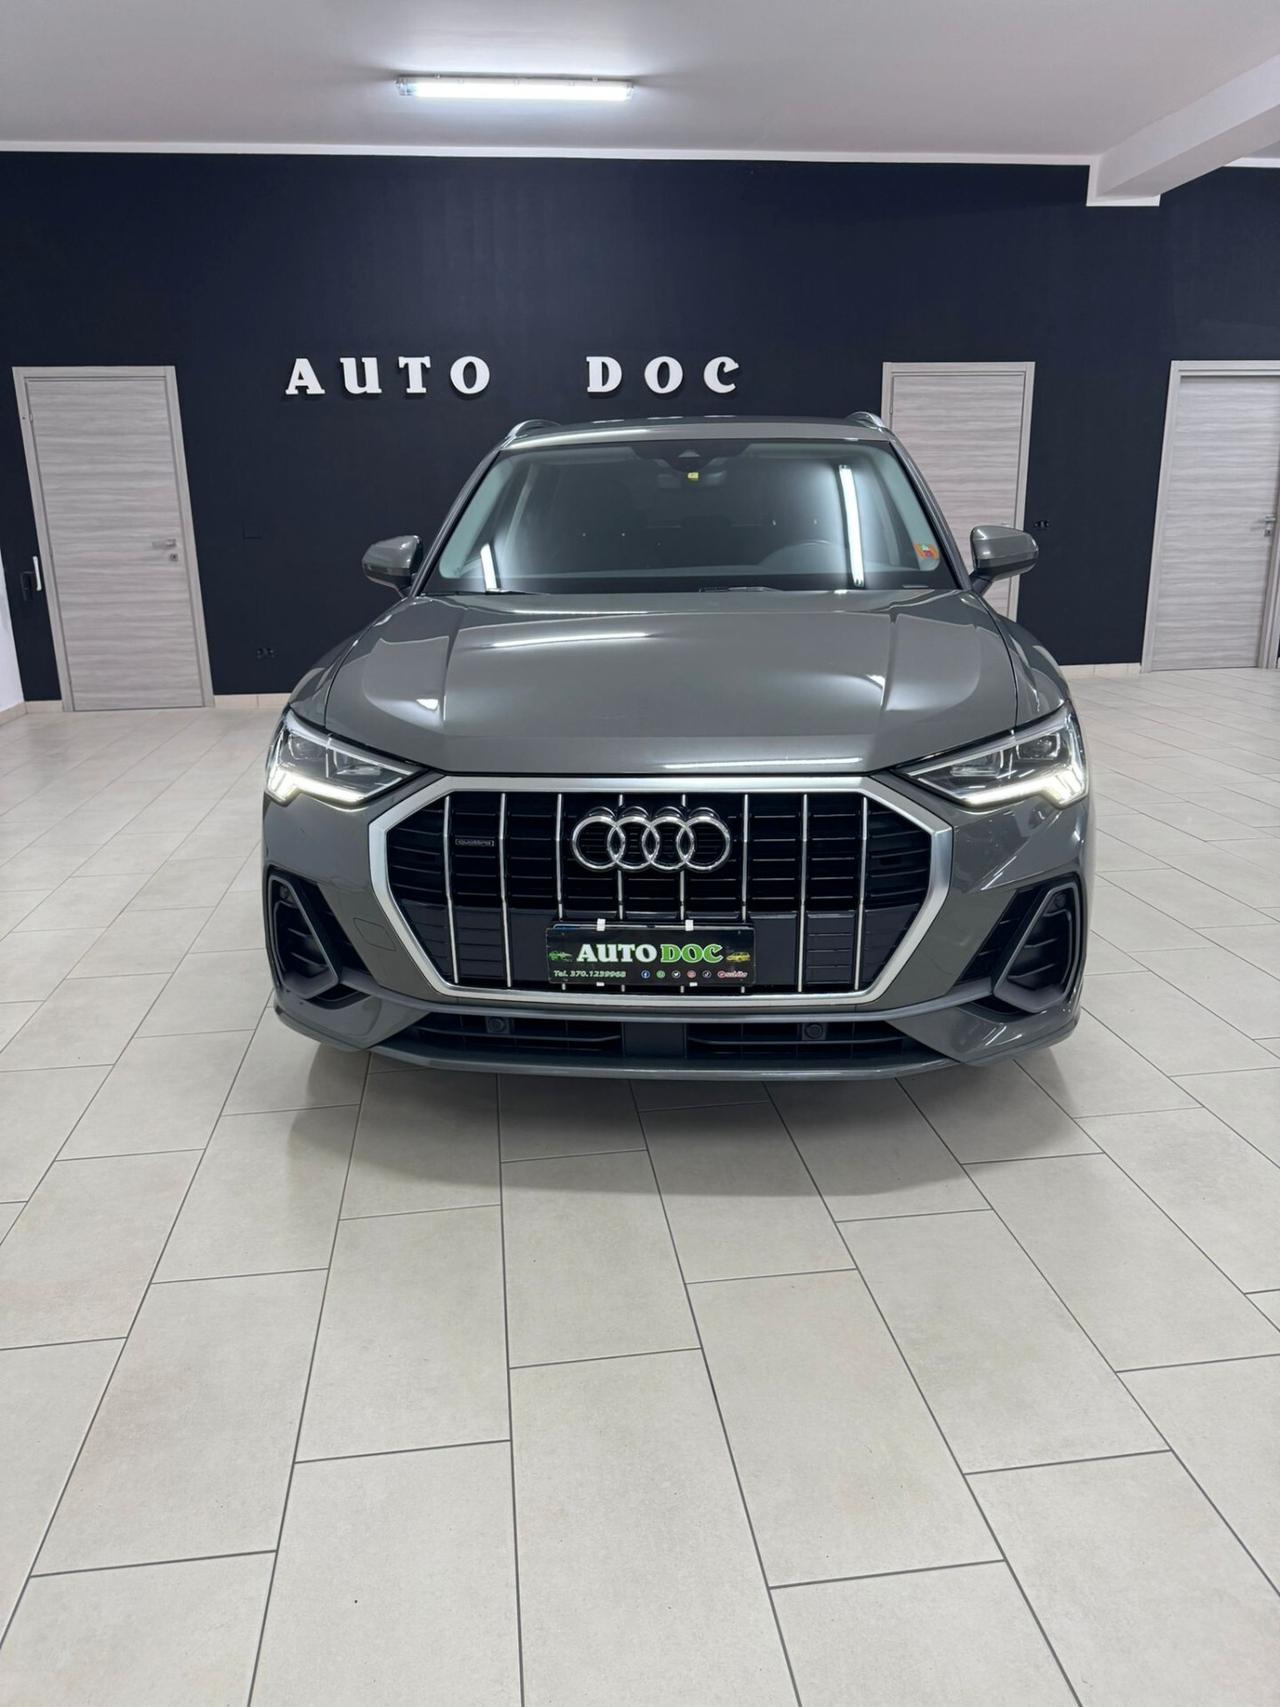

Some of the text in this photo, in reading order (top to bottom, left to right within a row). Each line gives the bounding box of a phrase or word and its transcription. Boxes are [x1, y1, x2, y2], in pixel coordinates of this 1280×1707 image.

[285, 355, 740, 395] AUTO DOC
[576, 943, 724, 963] AUTO DOC
[553, 969, 568, 978] Tel.
